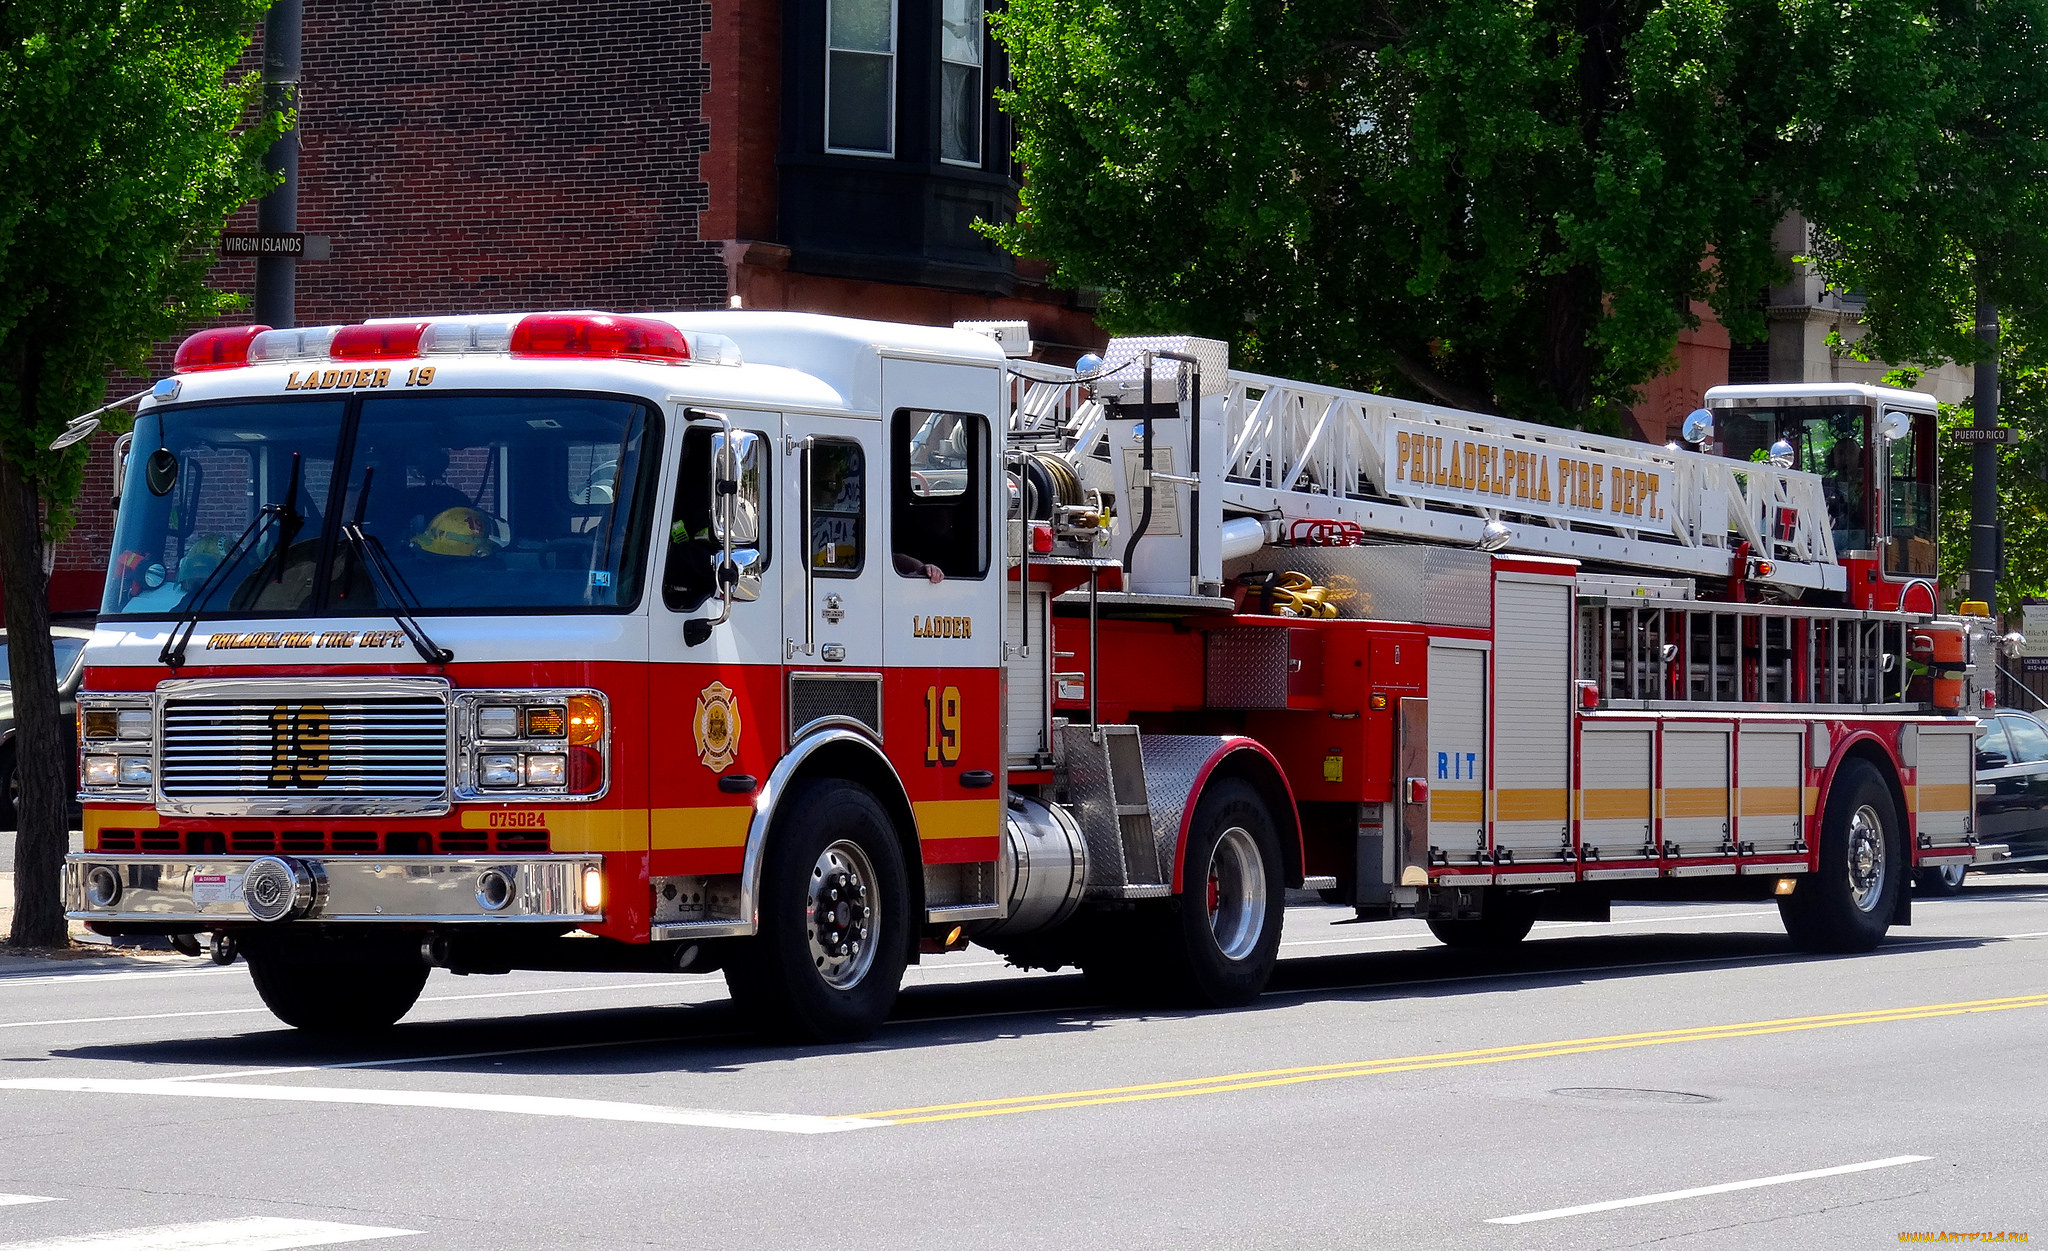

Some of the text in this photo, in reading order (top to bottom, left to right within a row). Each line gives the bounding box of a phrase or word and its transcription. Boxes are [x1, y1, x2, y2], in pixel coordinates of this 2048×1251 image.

[225, 237, 301, 252] VIRGIN ISLANDS
[285, 366, 437, 391] LADDER 19
[1954, 430, 2005, 440] PUERTO RICO
[1396, 430, 1664, 520] PHILADELPHIA FIRE DEPT.
[913, 615, 972, 639] LADDER
[206, 630, 405, 650] PHILADELPHIA FIRE DEPT.
[924, 685, 962, 768] 19
[268, 705, 330, 789] 19
[1437, 751, 1476, 780] RIT
[489, 812, 546, 827] 075024
[1962, 816, 1970, 830] 13
[1476, 829, 1483, 846] 3
[1561, 827, 1567, 843] 5
[1643, 825, 1650, 840] 7
[1721, 822, 1728, 839] 9
[1792, 821, 1799, 837] 11
